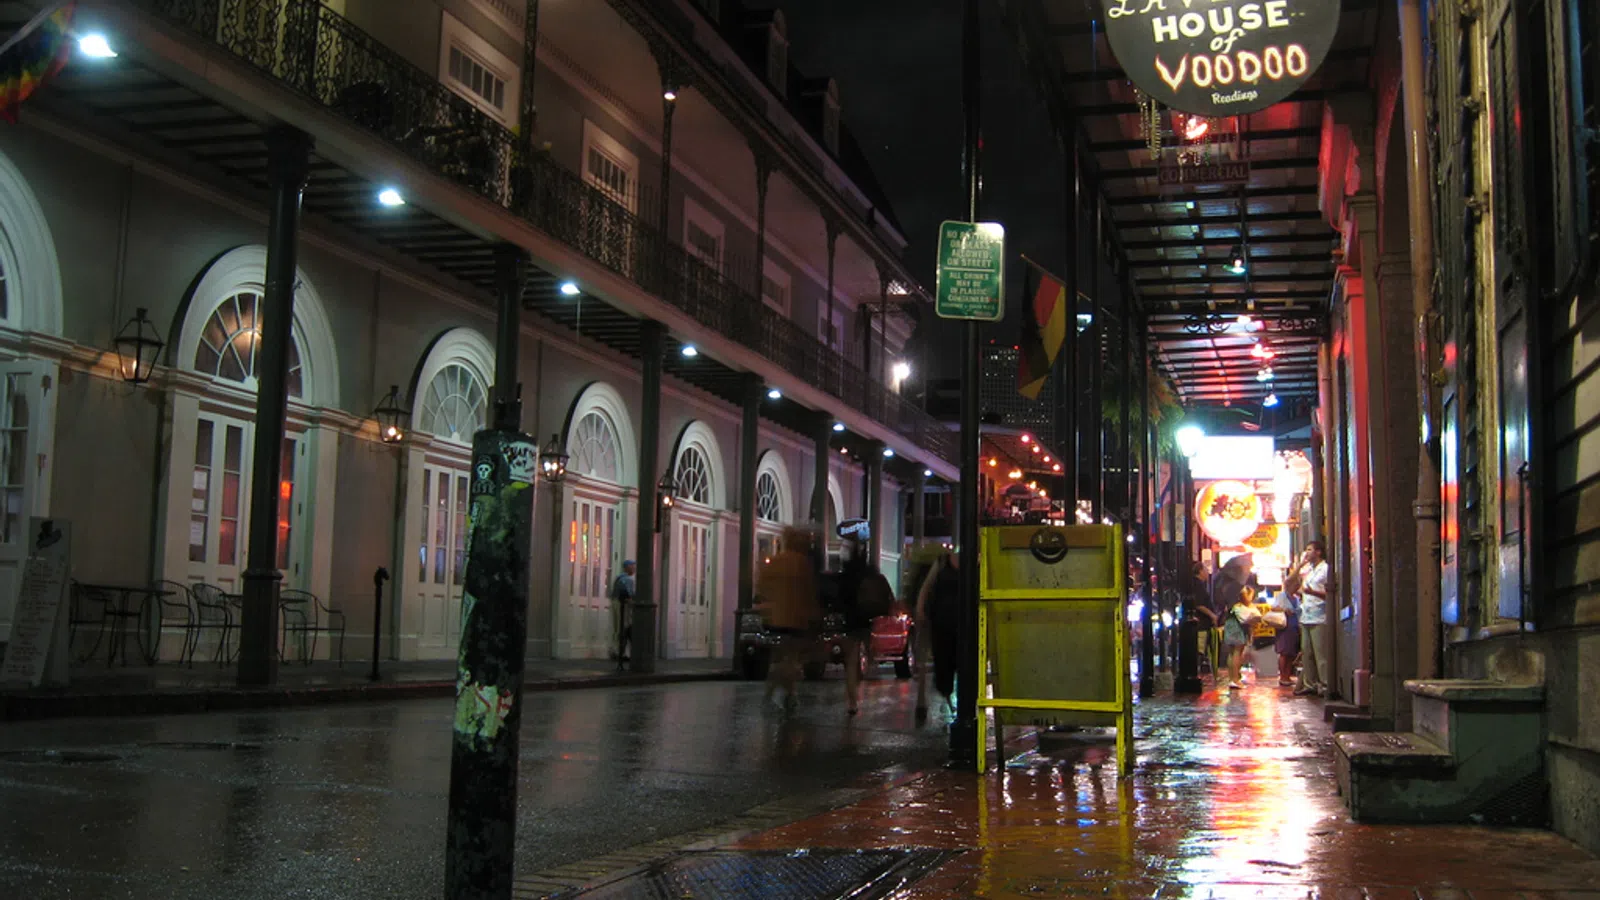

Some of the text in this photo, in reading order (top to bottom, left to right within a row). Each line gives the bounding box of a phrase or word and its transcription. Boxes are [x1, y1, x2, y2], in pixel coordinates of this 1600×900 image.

[1152, 0, 1290, 43] HOUSE
[1210, 28, 1246, 54] of
[1154, 43, 1308, 92] VOODOO
[1211, 89, 1259, 104] Readings
